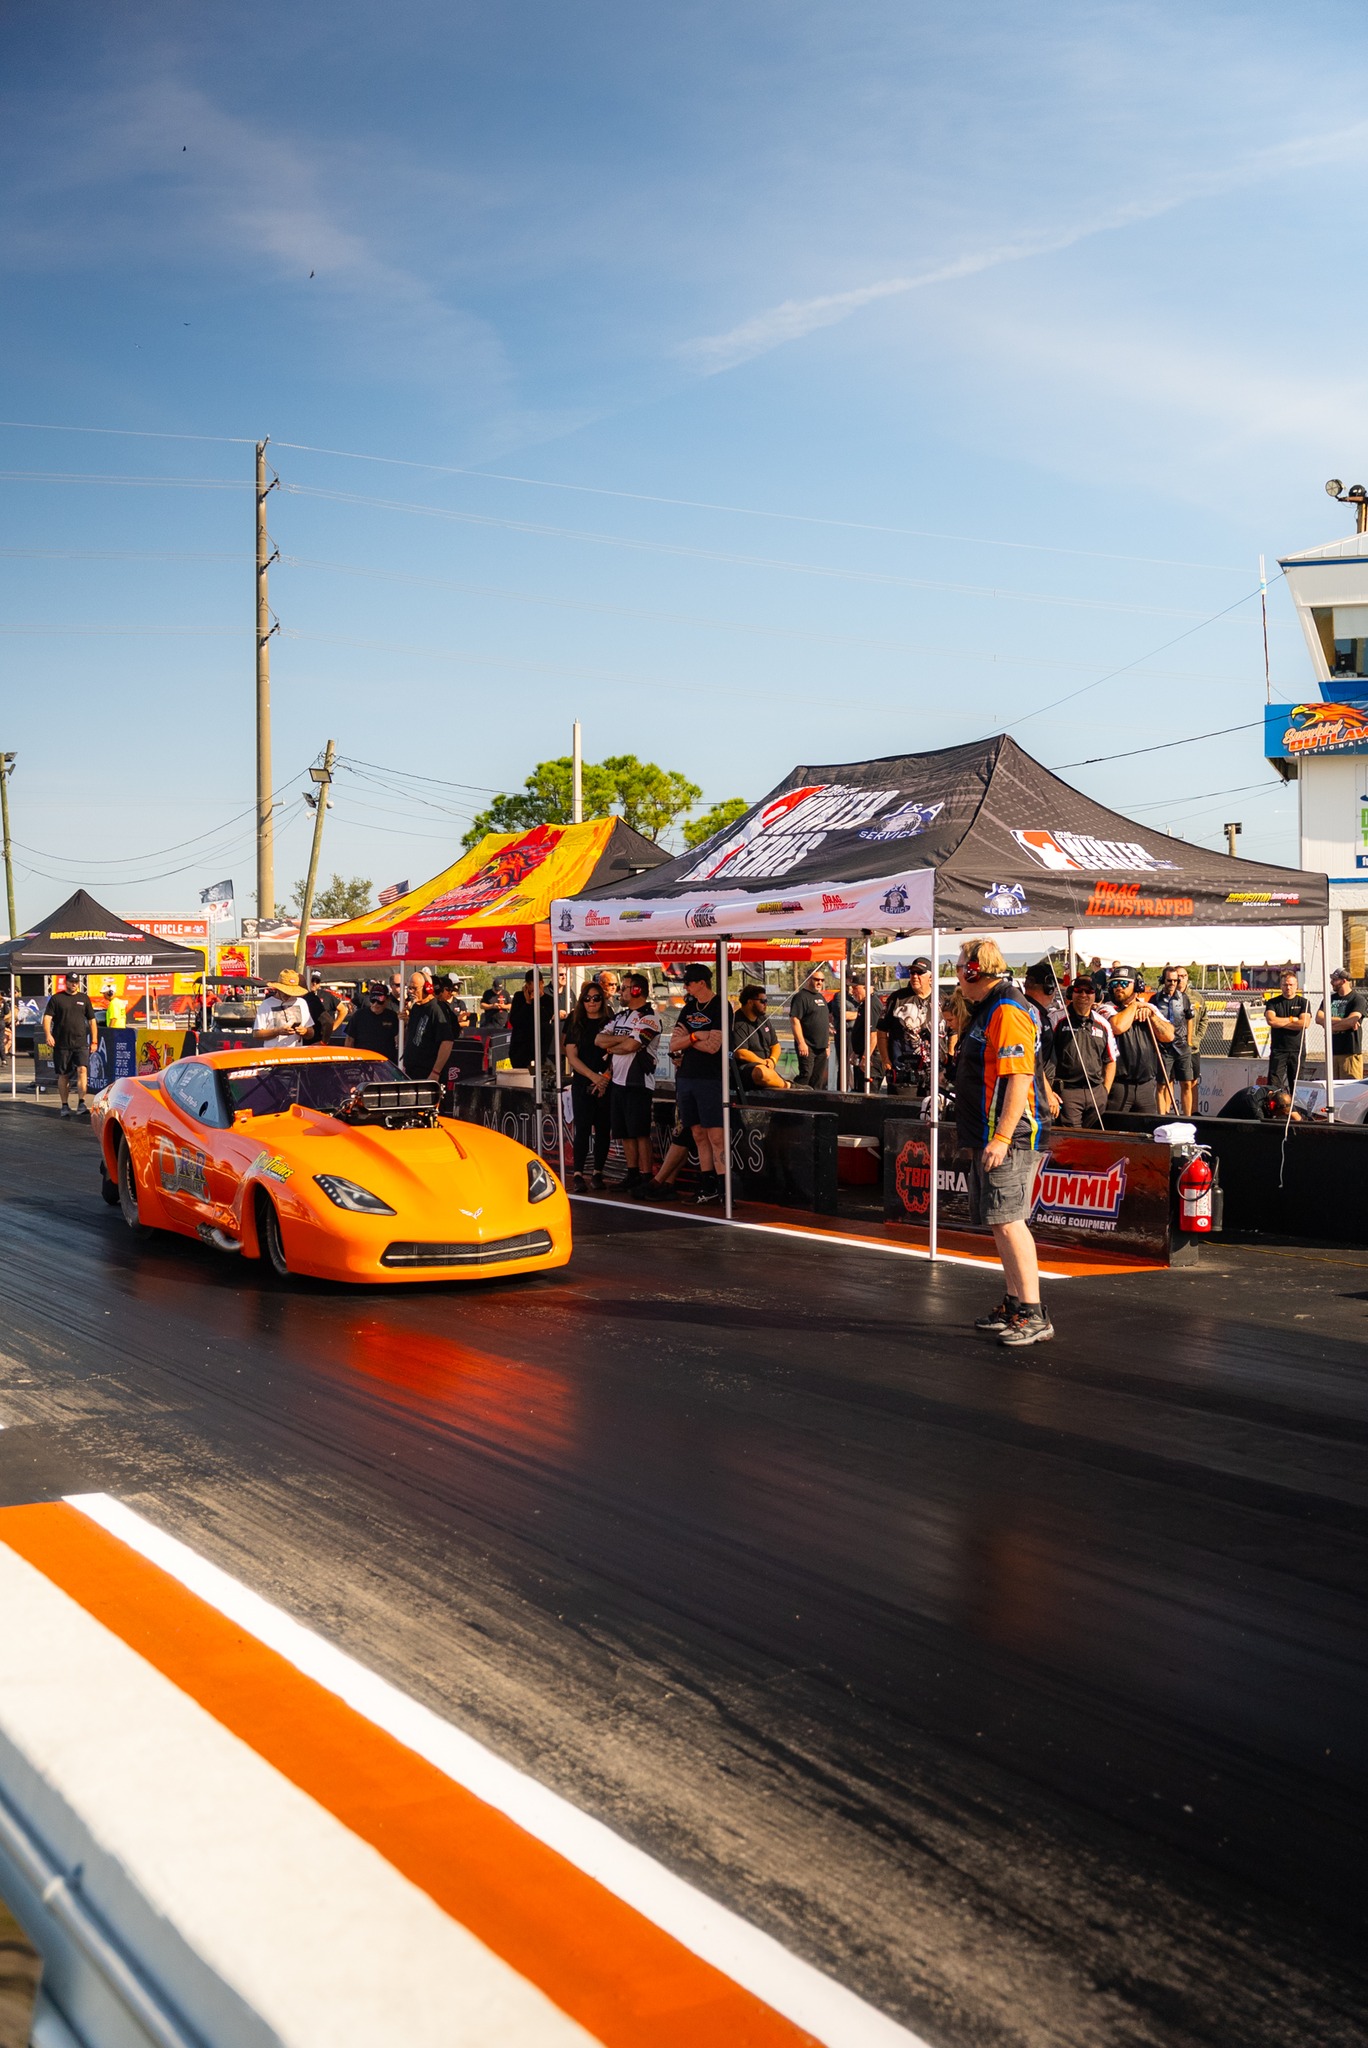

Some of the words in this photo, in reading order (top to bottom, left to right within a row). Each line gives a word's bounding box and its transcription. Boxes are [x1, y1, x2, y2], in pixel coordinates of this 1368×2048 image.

[1283, 719, 1343, 744] Snowbird
[880, 801, 945, 821] J&A
[858, 828, 923, 841] SERVICE
[1058, 839, 1155, 861] WINTER
[1073, 856, 1158, 872] SERIES
[984, 882, 1027, 900] J&A
[1094, 881, 1140, 900] DRAG
[983, 906, 1030, 917] SERVICE
[1085, 896, 1194, 916] ILLUSTRATED
[50, 930, 107, 940] BRADENTON
[153, 923, 183, 935] CIRCLE
[654, 941, 742, 956] ILLUSTRAED
[67, 955, 153, 967] WWW.RACEBMP.COM
[87, 1077, 108, 1089] ERVICE
[937, 1169, 969, 1193] BRA
[1036, 1213, 1067, 1226] RACING
[1068, 1216, 1117, 1232] EQUIPMENT
